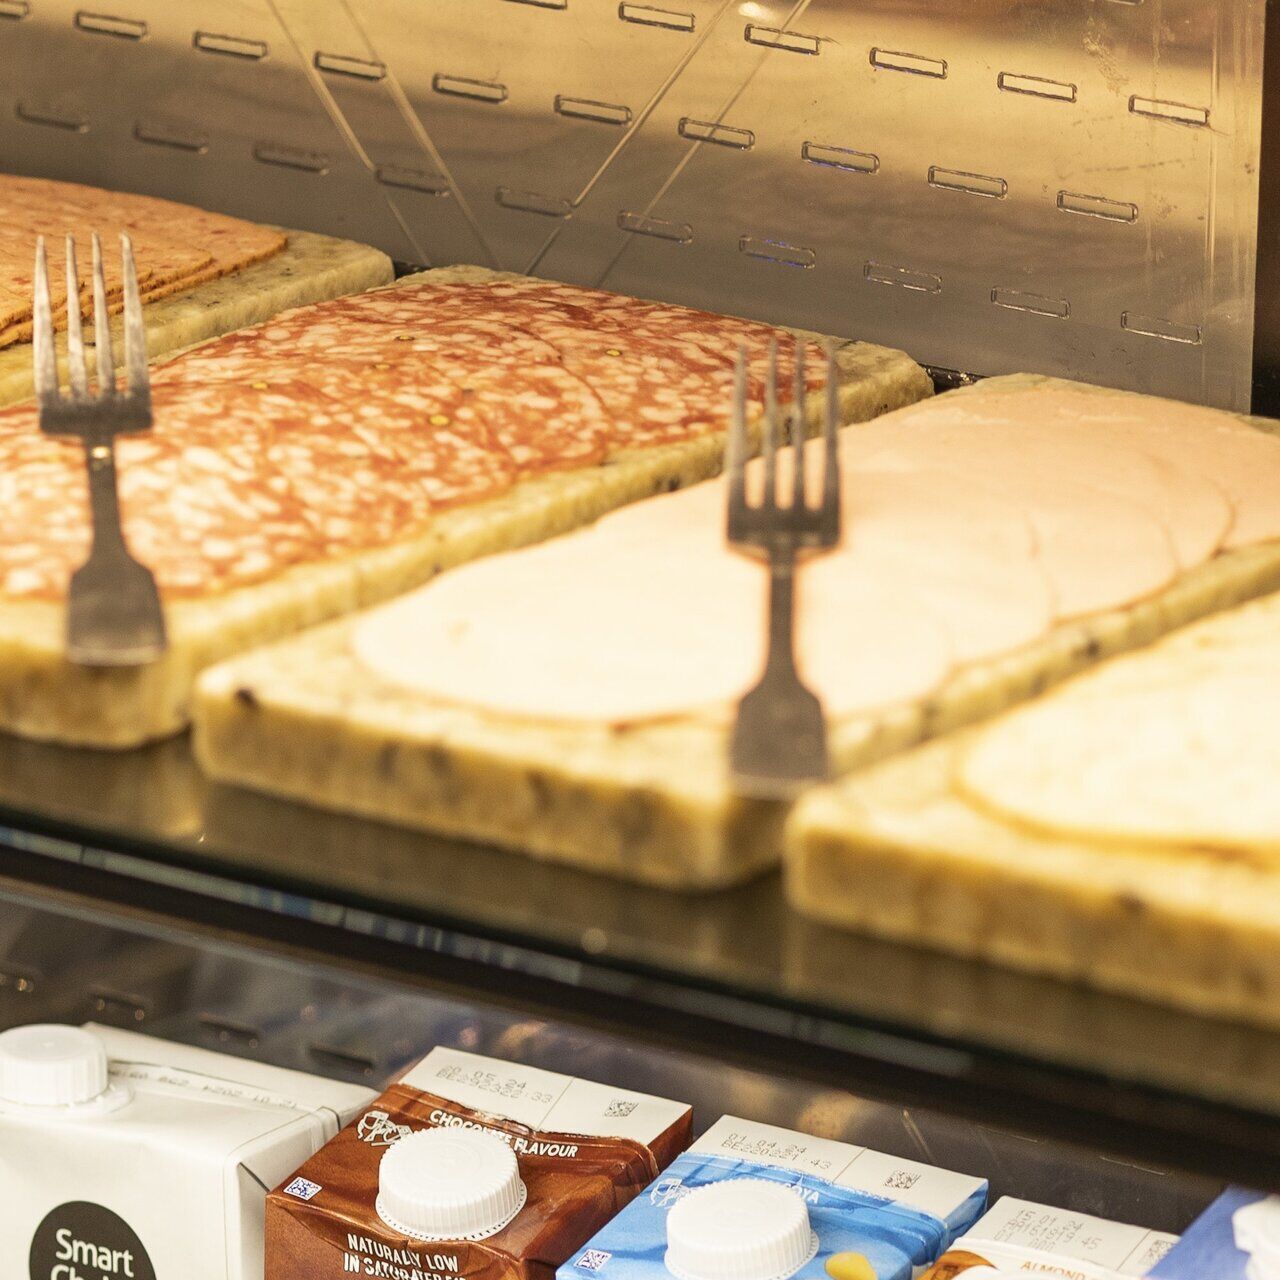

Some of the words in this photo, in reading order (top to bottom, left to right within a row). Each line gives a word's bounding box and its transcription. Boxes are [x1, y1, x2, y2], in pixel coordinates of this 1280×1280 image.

[513, 1137, 579, 1158] FLAVOUR
[55, 1228, 133, 1278] Smart
[343, 1252, 360, 1274] IN
[346, 1233, 422, 1268] NATURALLY
[424, 1253, 459, 1273] LOW
